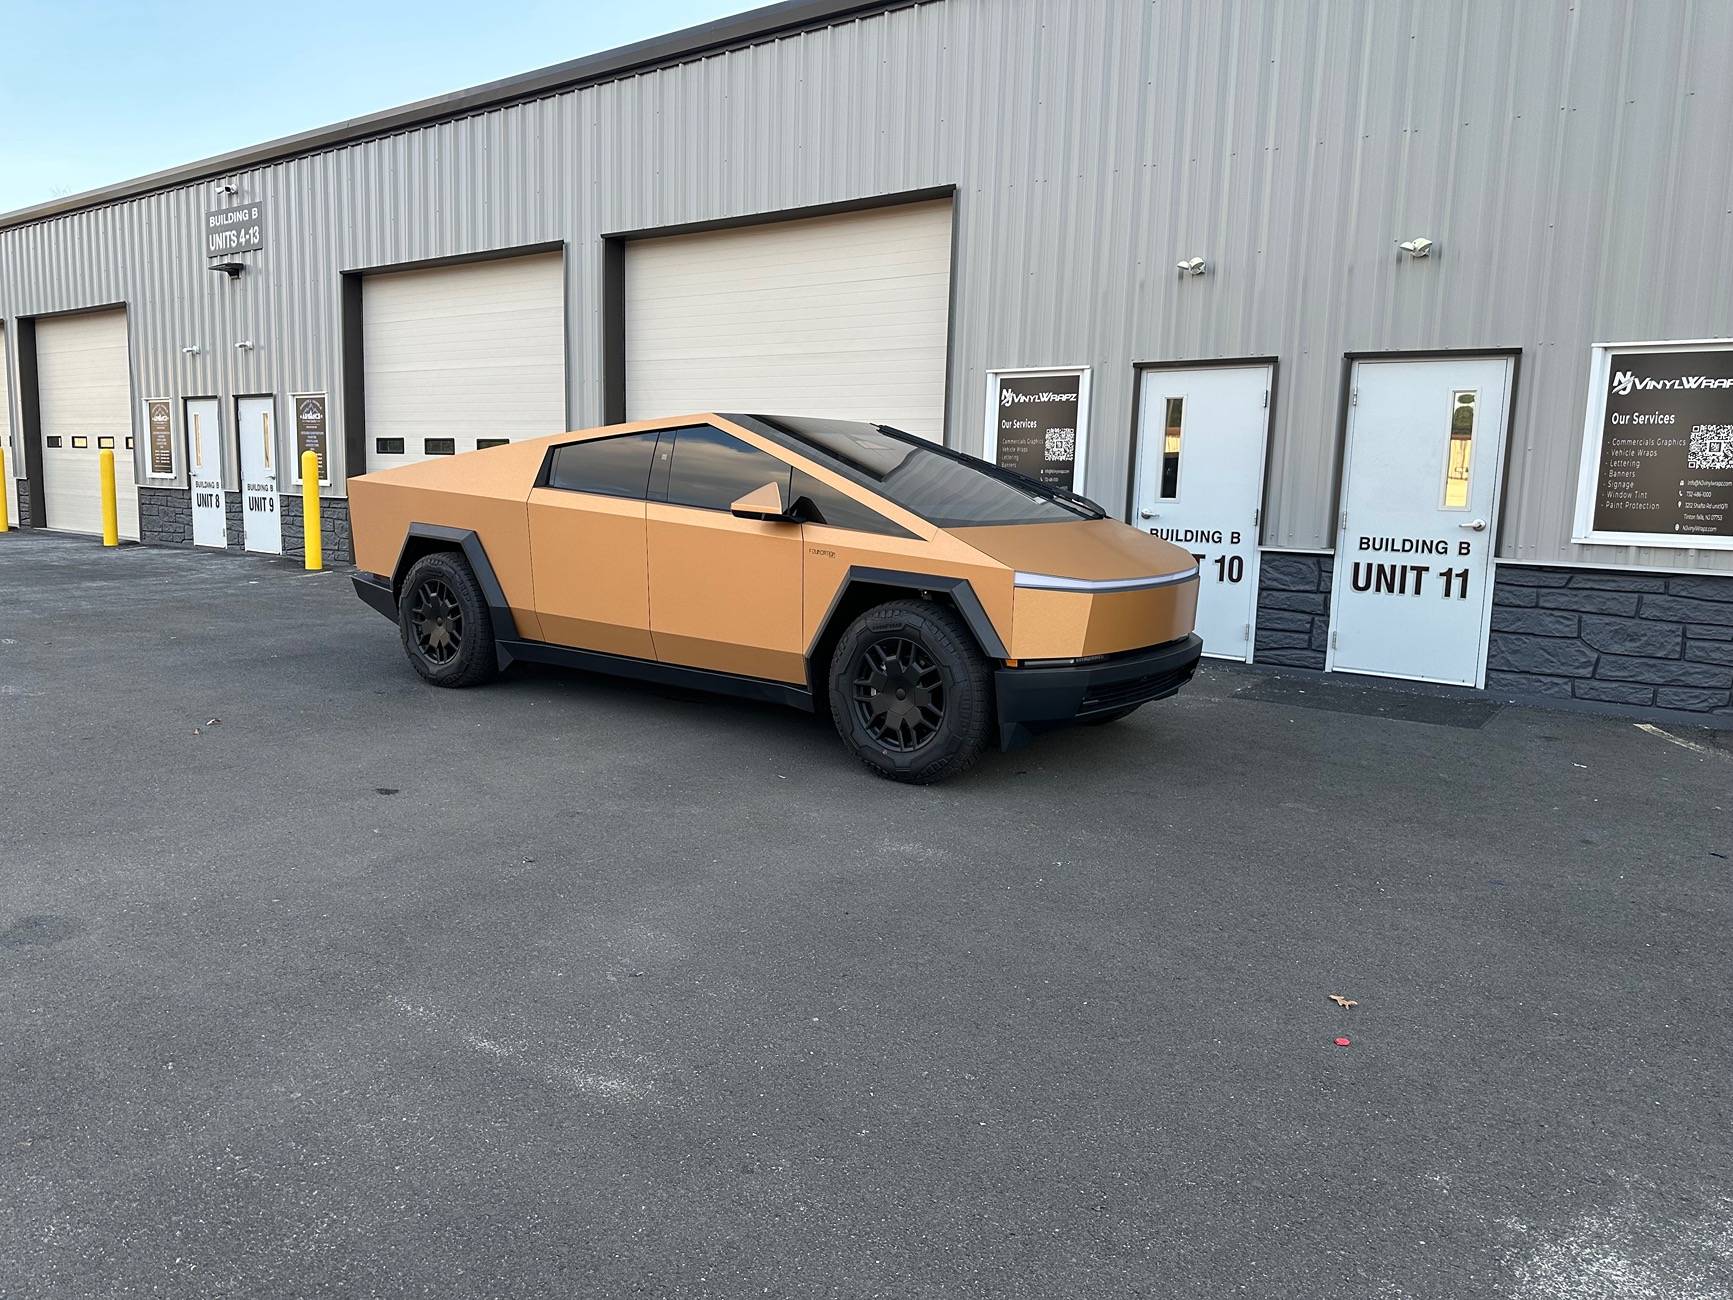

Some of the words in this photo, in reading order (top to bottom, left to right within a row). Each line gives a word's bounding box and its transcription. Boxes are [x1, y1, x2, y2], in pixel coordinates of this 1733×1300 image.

[209, 210, 248, 227] BUILDING
[251, 207, 258, 219] B
[209, 230, 237, 251] UNITS
[239, 226, 260, 246] 4-13
[1001, 420, 1012, 429] Our
[1013, 418, 1037, 429] Services
[1611, 412, 1630, 425] Our
[1632, 411, 1675, 425] Services
[1612, 437, 1655, 446] Commercials
[1656, 438, 1686, 447] Graphics
[1611, 448, 1635, 457] Vehicle
[1637, 449, 1658, 457] Wraps
[1609, 460, 1641, 469] Lettering
[1608, 469, 1636, 478] Banners
[195, 481, 215, 489] BUILDING
[216, 481, 220, 489] B
[247, 483, 269, 492] BUILDING
[270, 484, 274, 492] B
[1607, 480, 1634, 489] Signage
[1606, 490, 1633, 498] Window
[1634, 490, 1648, 499] Tint
[196, 493, 213, 508] UNIT
[215, 494, 220, 509] 8
[248, 496, 267, 512] UNIT
[268, 497, 275, 513] 9
[1605, 500, 1623, 509] Paint
[1624, 501, 1660, 510] Protection
[1149, 527, 1223, 544] BUILDING
[1230, 531, 1241, 545] B
[1358, 536, 1449, 555] BUILDING
[1458, 541, 1471, 556] B
[1214, 554, 1244, 583] 10
[1351, 561, 1430, 596] UNIT
[1438, 566, 1470, 599] 11
